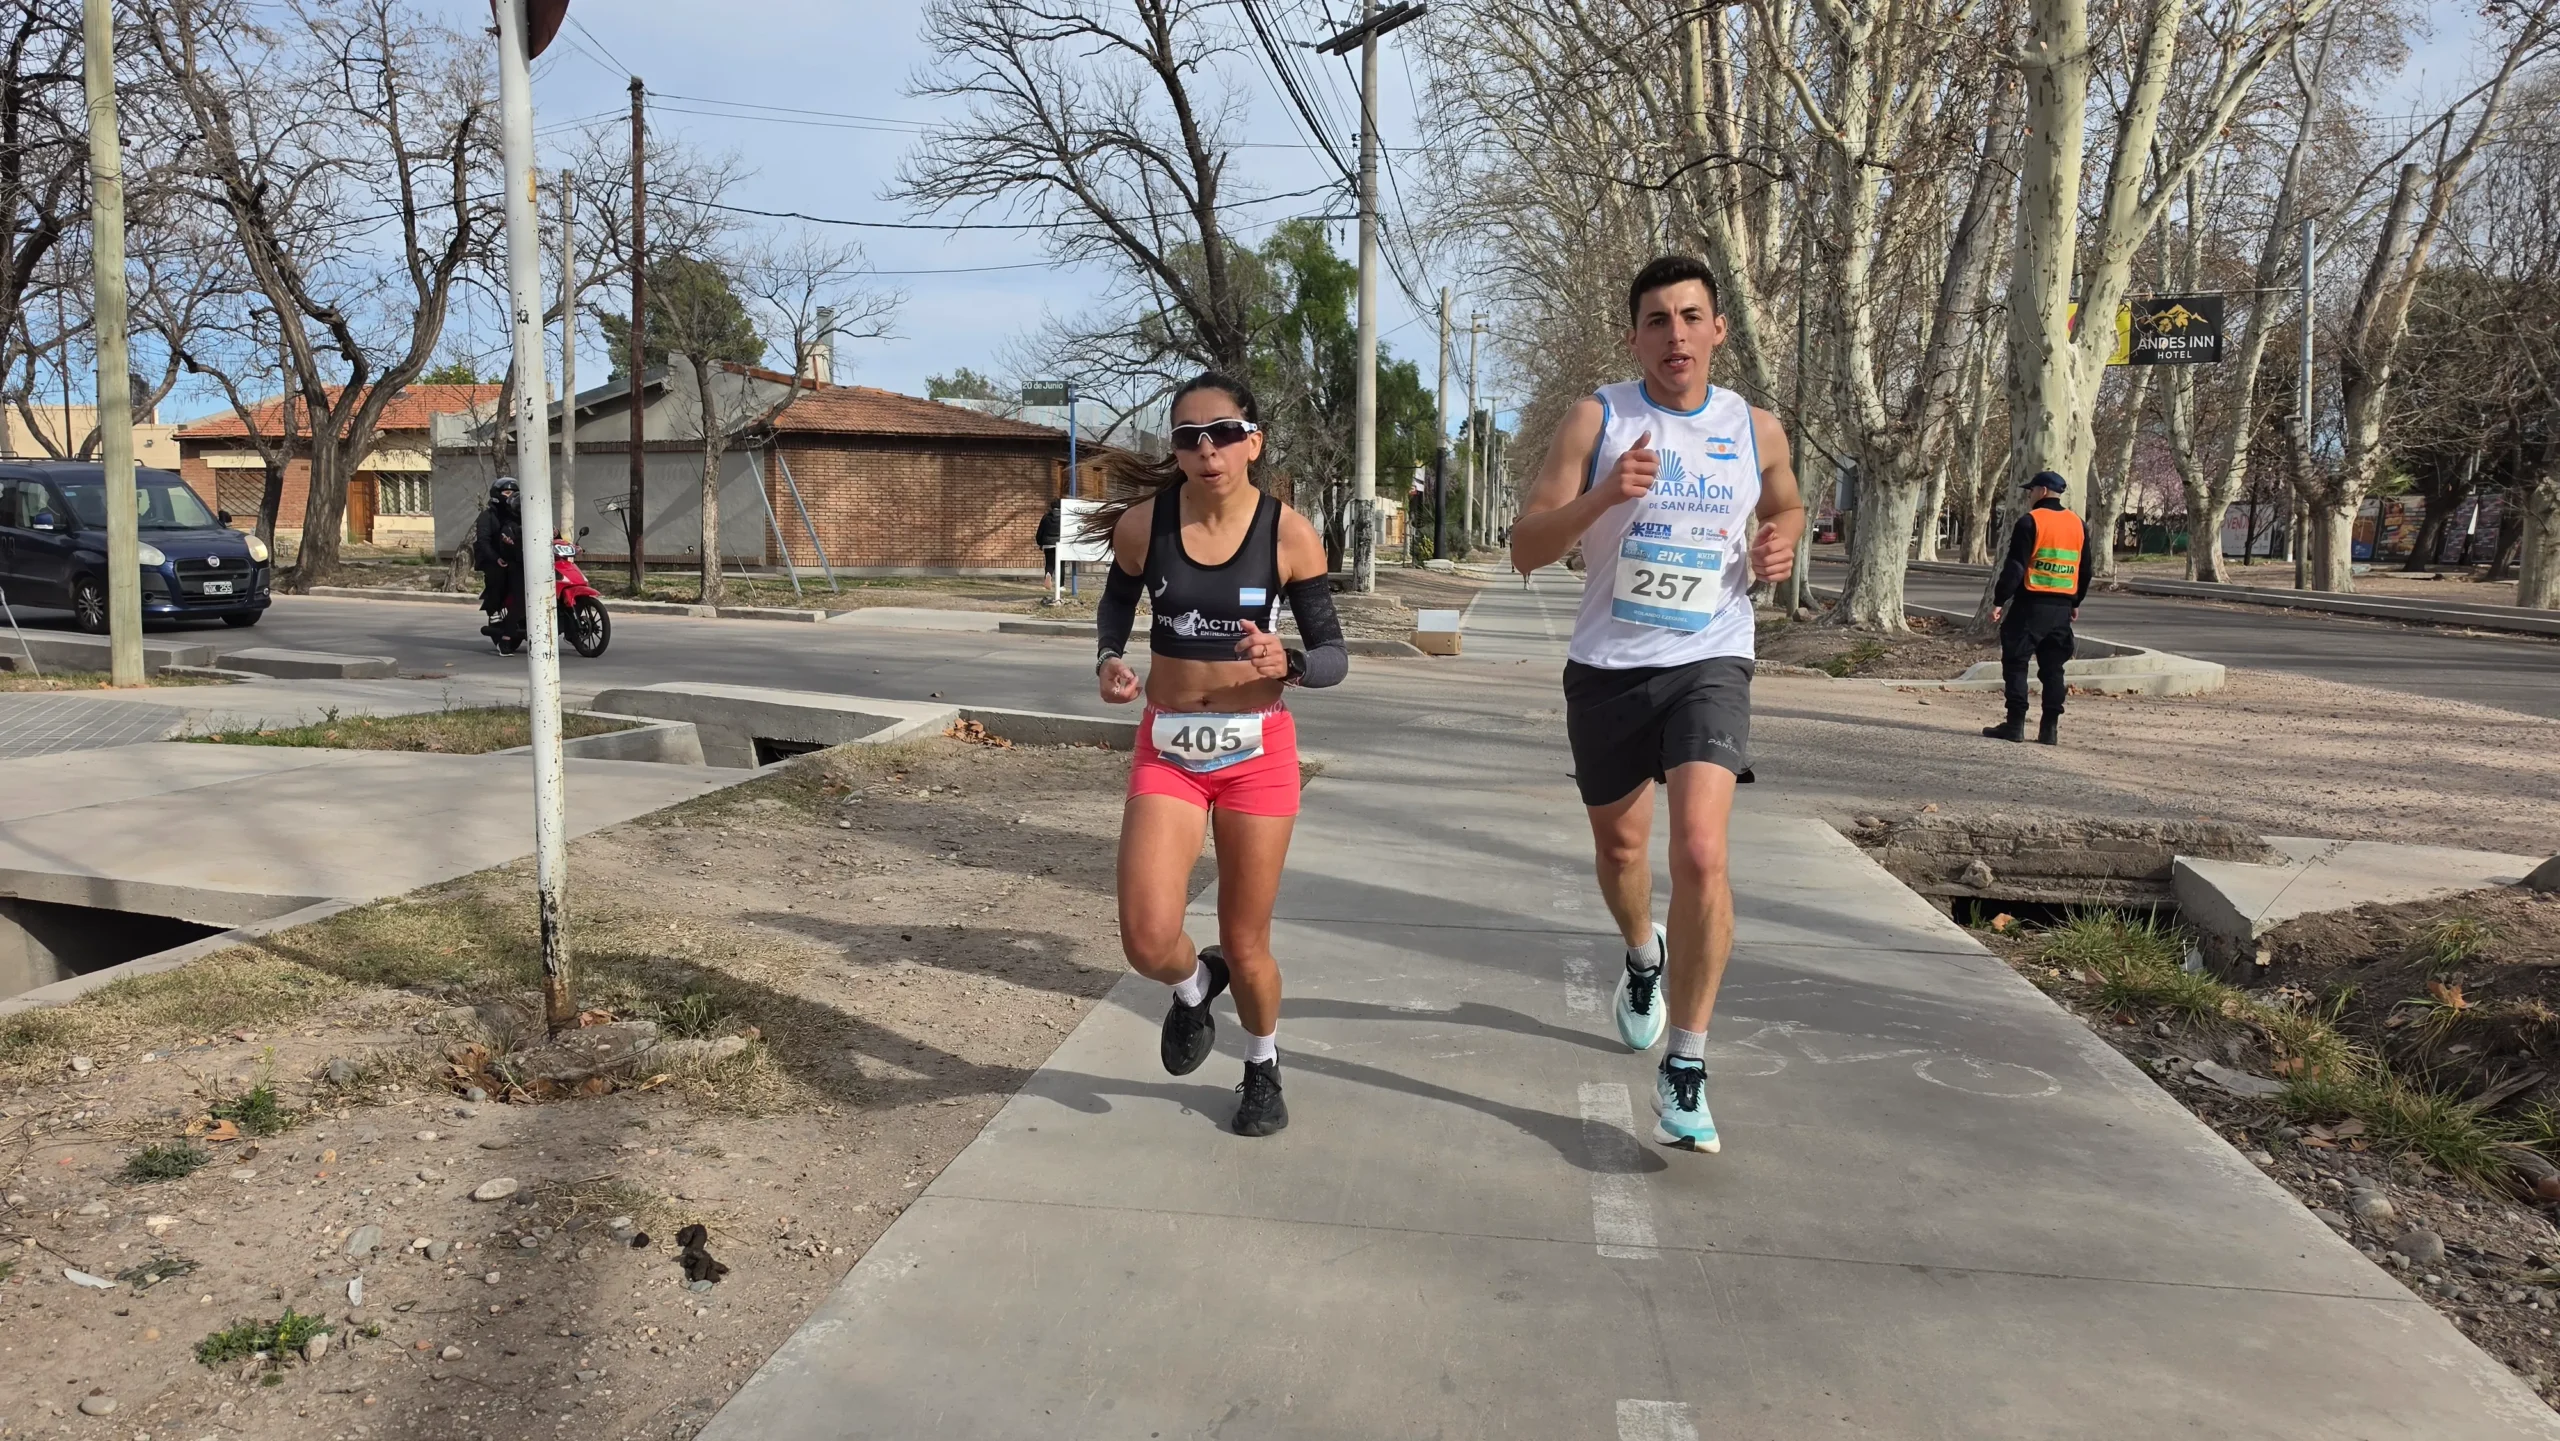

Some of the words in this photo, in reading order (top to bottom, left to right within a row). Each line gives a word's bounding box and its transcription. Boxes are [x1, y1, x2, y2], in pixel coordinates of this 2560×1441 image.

[2138, 336, 2186, 350] ANDES
[2189, 335, 2215, 348] INN
[2157, 350, 2193, 359] HOTEL
[1022, 381, 1033, 390] 20
[1033, 381, 1043, 390] de
[1043, 381, 1064, 390] Junio
[1660, 501, 1686, 512] SAN
[1687, 503, 1731, 515] RAFAEL
[1645, 522, 1672, 533] UTN
[1656, 550, 1687, 564] 21K
[2035, 560, 2075, 574] POLICIA
[1630, 568, 1703, 602] 257
[1633, 609, 1661, 619] ROLANDO
[1171, 725, 1242, 754] 405
